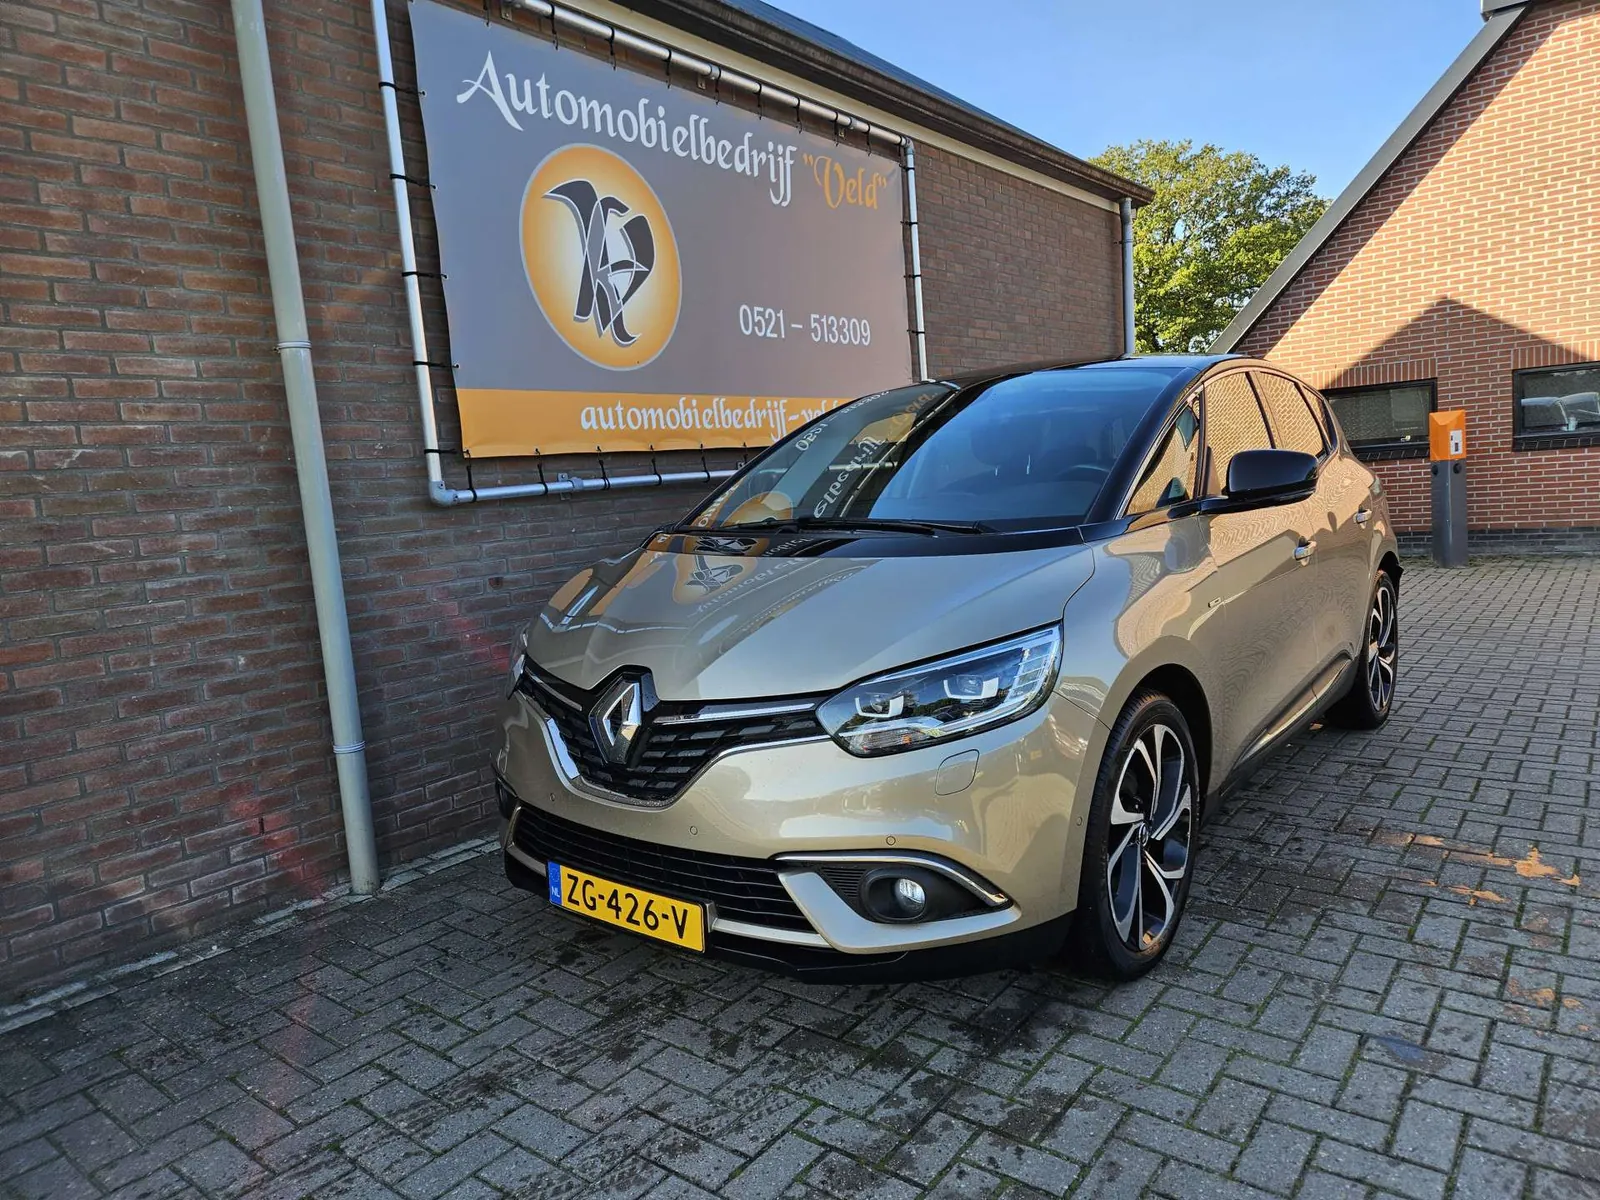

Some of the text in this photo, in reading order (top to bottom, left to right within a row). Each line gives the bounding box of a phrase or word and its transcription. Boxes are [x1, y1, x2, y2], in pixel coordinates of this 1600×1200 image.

[456, 50, 798, 207] Automobielbedrijf
[739, 304, 786, 339] 0521
[810, 313, 871, 346] 513309
[551, 886, 561, 898] NL
[566, 873, 688, 939] ZG-426-V
